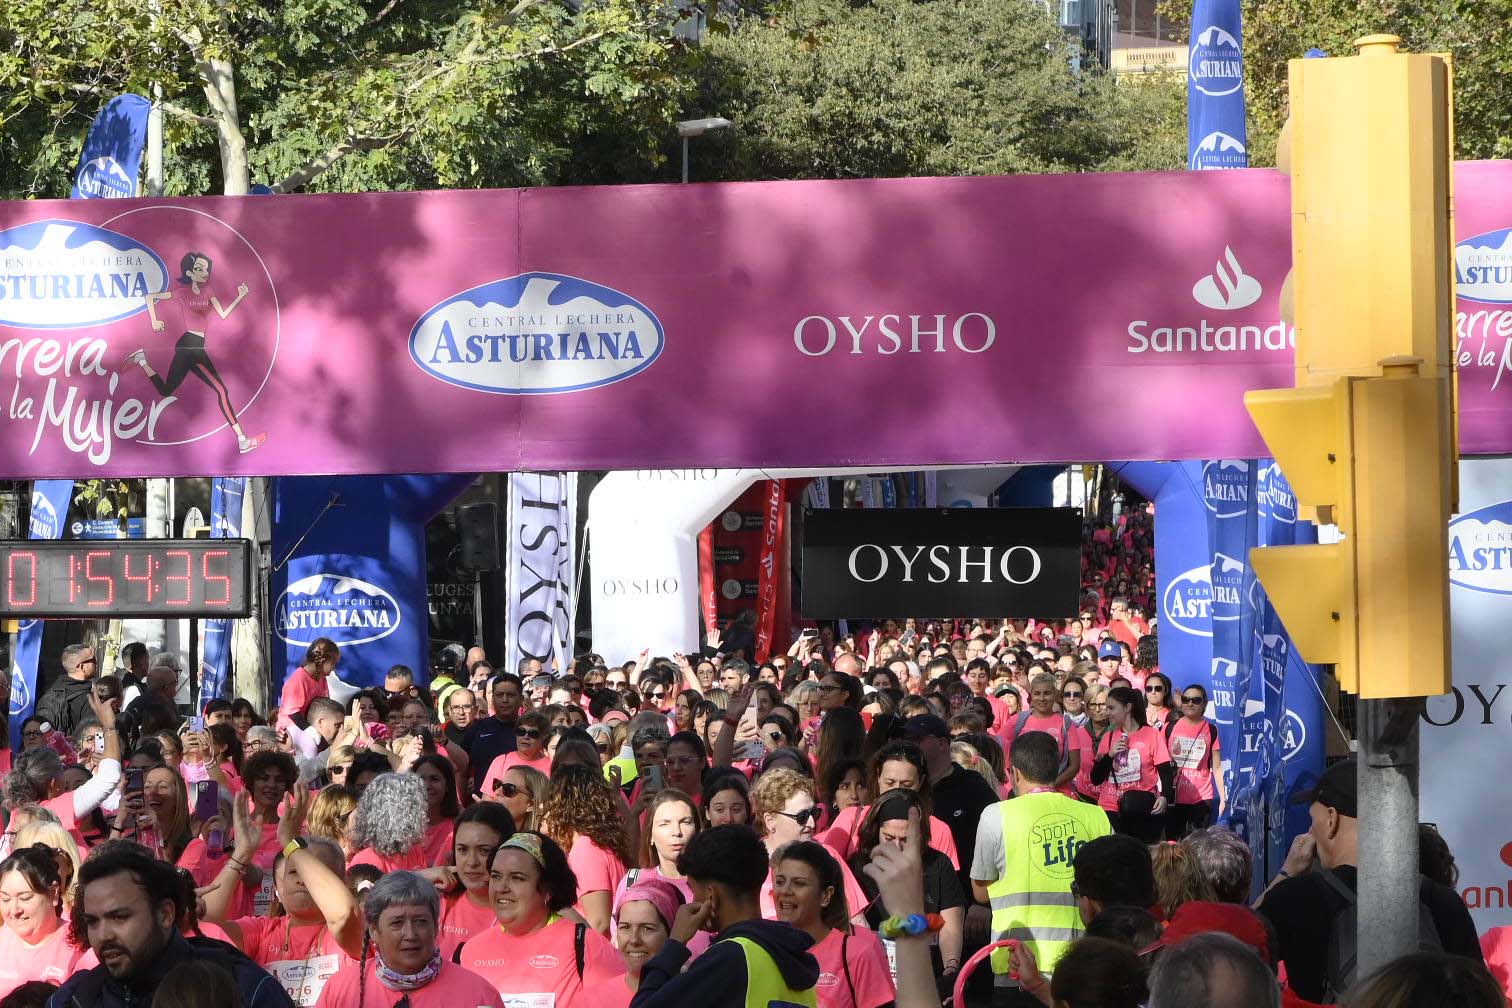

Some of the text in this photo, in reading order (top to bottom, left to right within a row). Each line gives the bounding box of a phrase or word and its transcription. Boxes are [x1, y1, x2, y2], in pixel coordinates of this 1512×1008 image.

[1469, 254, 1512, 264] CENTRA
[467, 312, 636, 329] CENTRAL LECHERA
[793, 311, 996, 358] OYSHO
[429, 319, 645, 365] ASTURIANA
[9, 382, 34, 420] la
[29, 372, 179, 466] Mujer
[848, 544, 1041, 584] OYSHO
[277, 604, 392, 630] ASTURIANA
[290, 599, 333, 608] CENTRAL
[1420, 684, 1512, 727] OY
[1031, 819, 1078, 845] Sport
